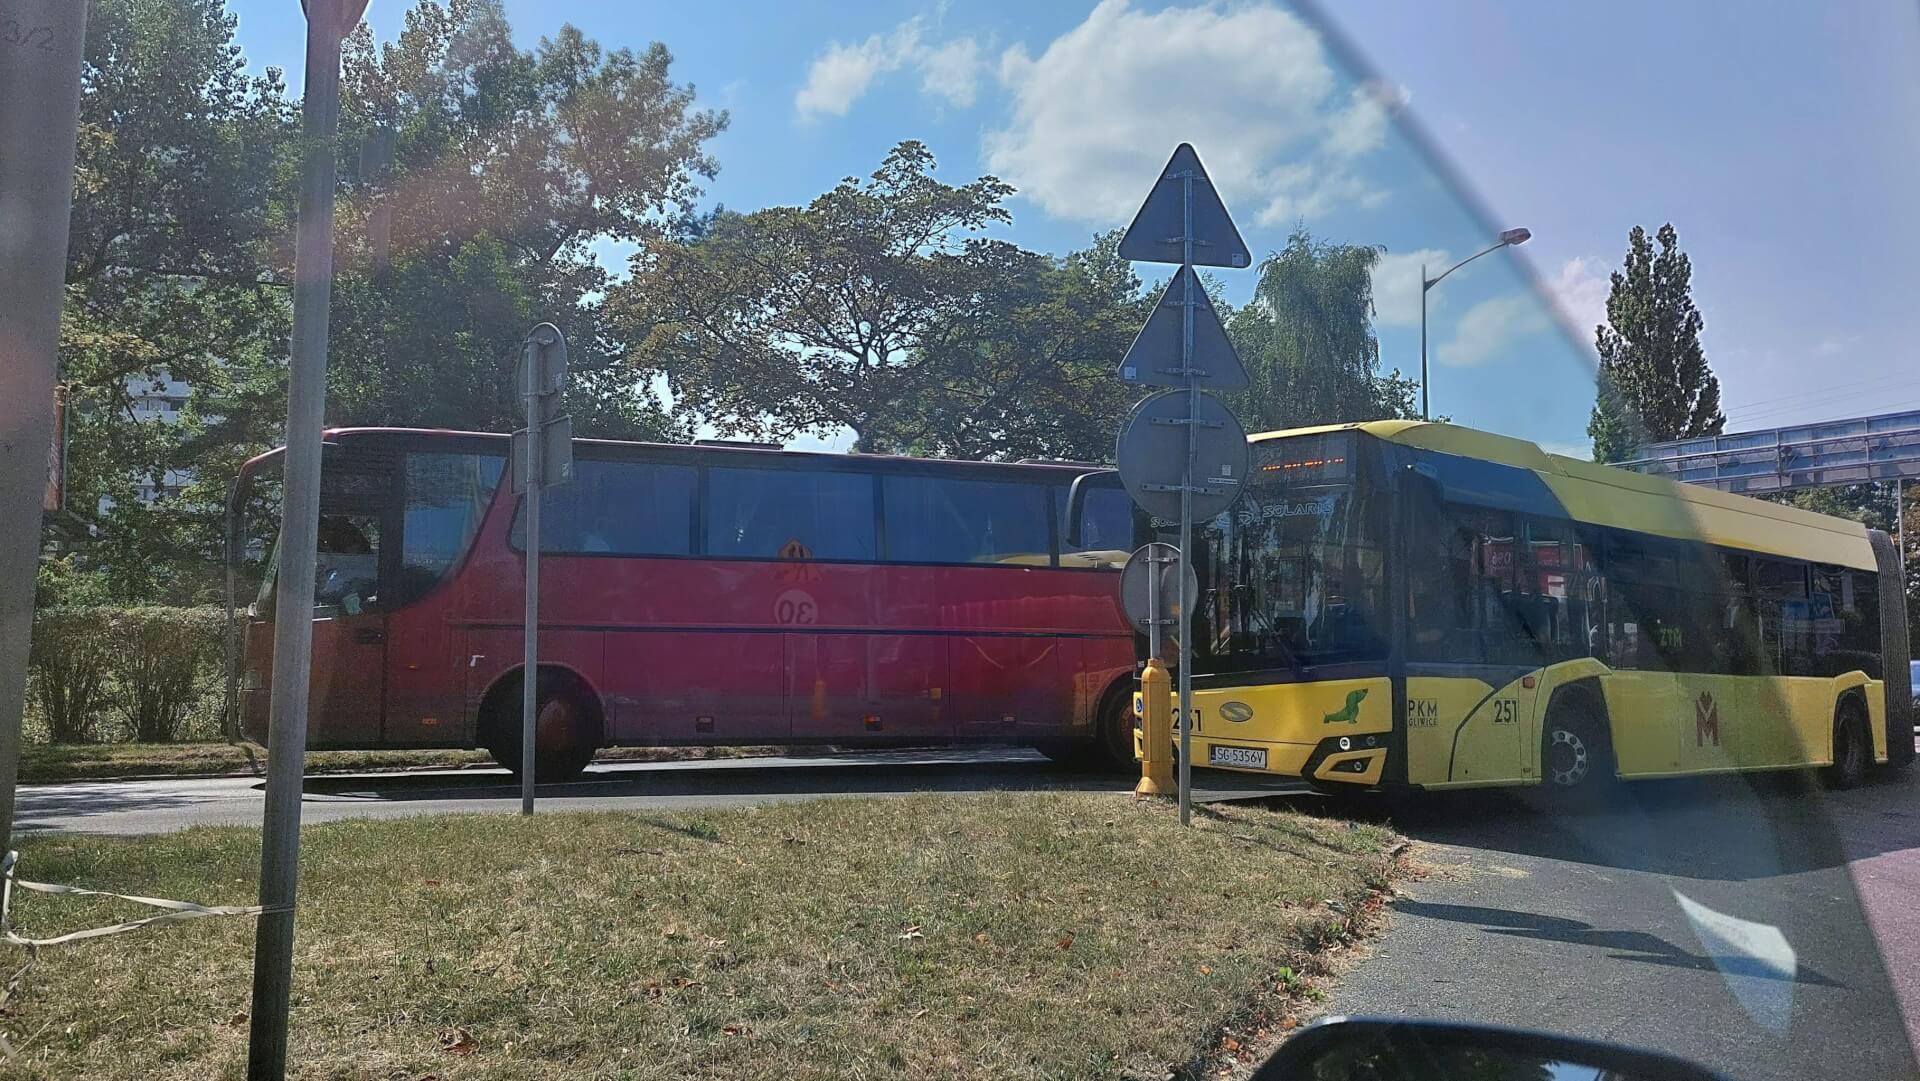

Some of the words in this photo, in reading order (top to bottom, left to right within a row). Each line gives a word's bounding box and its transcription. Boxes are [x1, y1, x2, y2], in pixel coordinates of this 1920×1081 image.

[1262, 503, 1334, 518] SOLARIS
[1408, 700, 1437, 717] PKM
[1494, 700, 1517, 723] 251
[1408, 718, 1438, 727] GLIWICE
[1217, 748, 1230, 761] SG
[1233, 750, 1263, 763] 5356V
